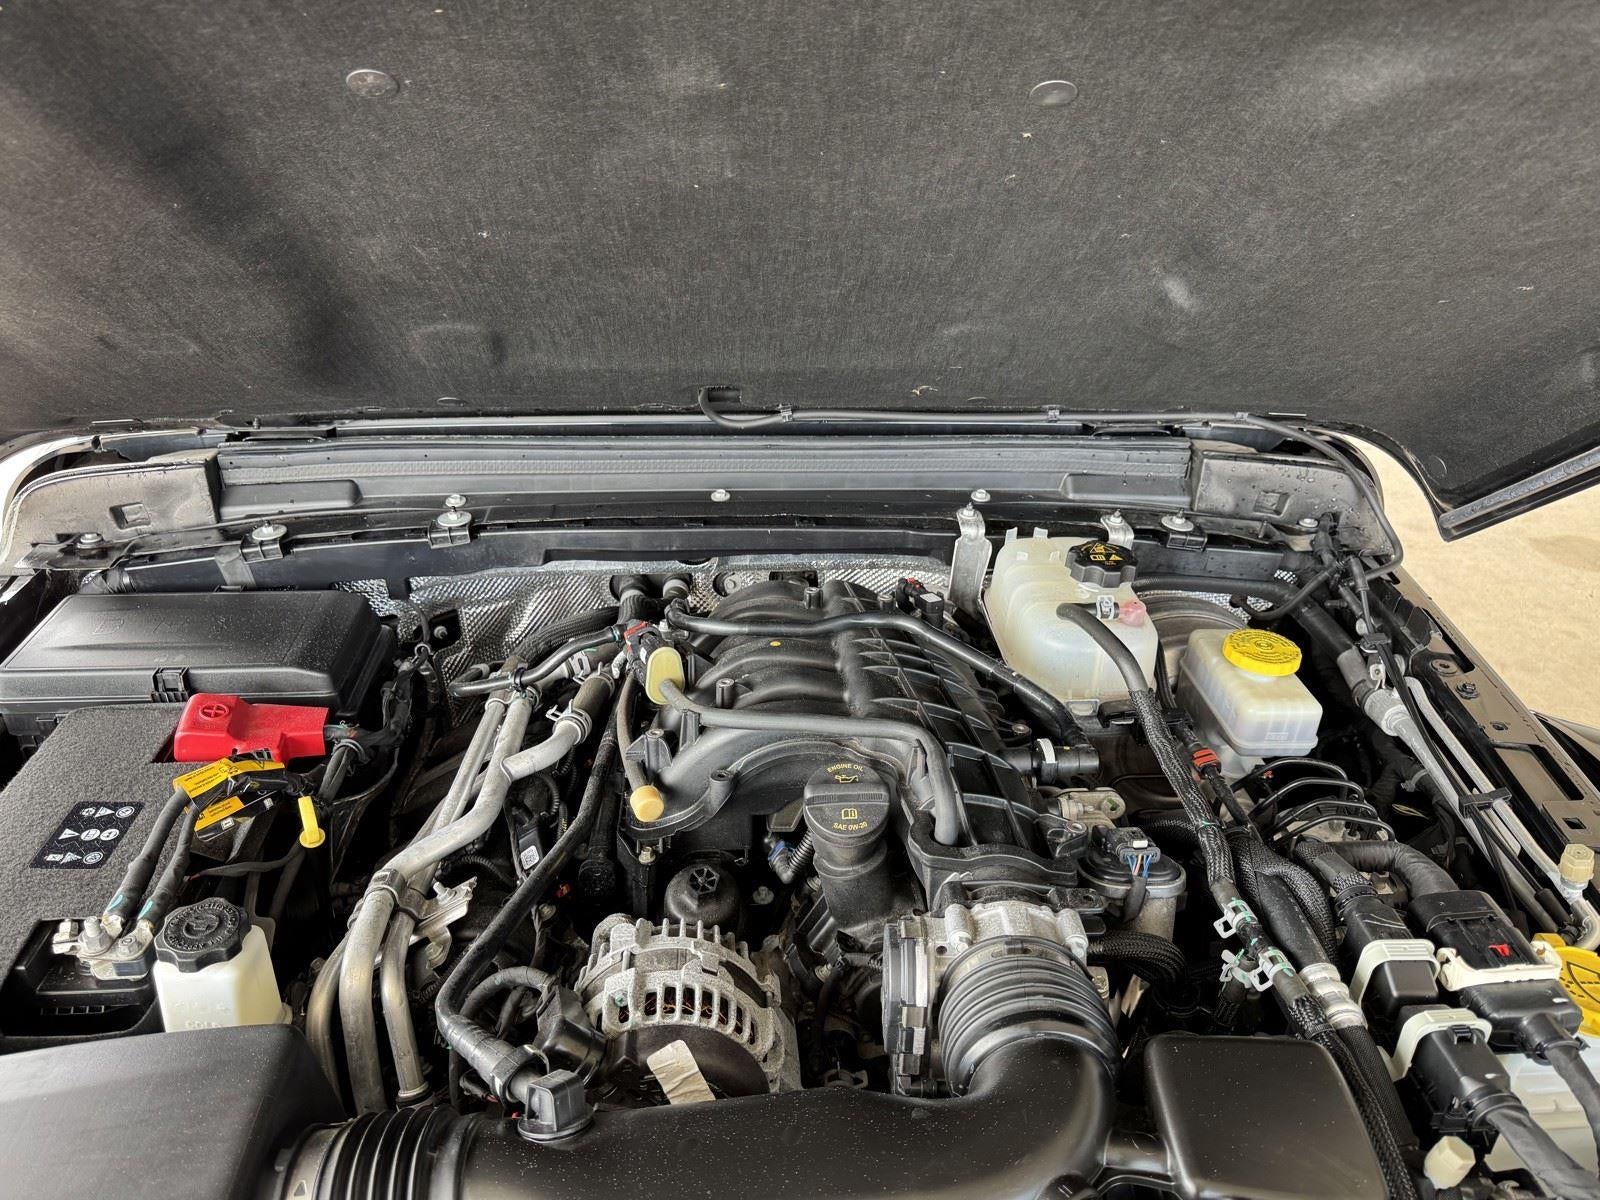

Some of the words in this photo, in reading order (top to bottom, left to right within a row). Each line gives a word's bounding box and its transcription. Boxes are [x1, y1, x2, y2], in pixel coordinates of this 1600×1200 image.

[827, 763, 852, 773] ENGINE
[853, 764, 863, 772] OIL
[832, 822, 847, 831] SAE
[848, 821, 868, 831] 0W-20
